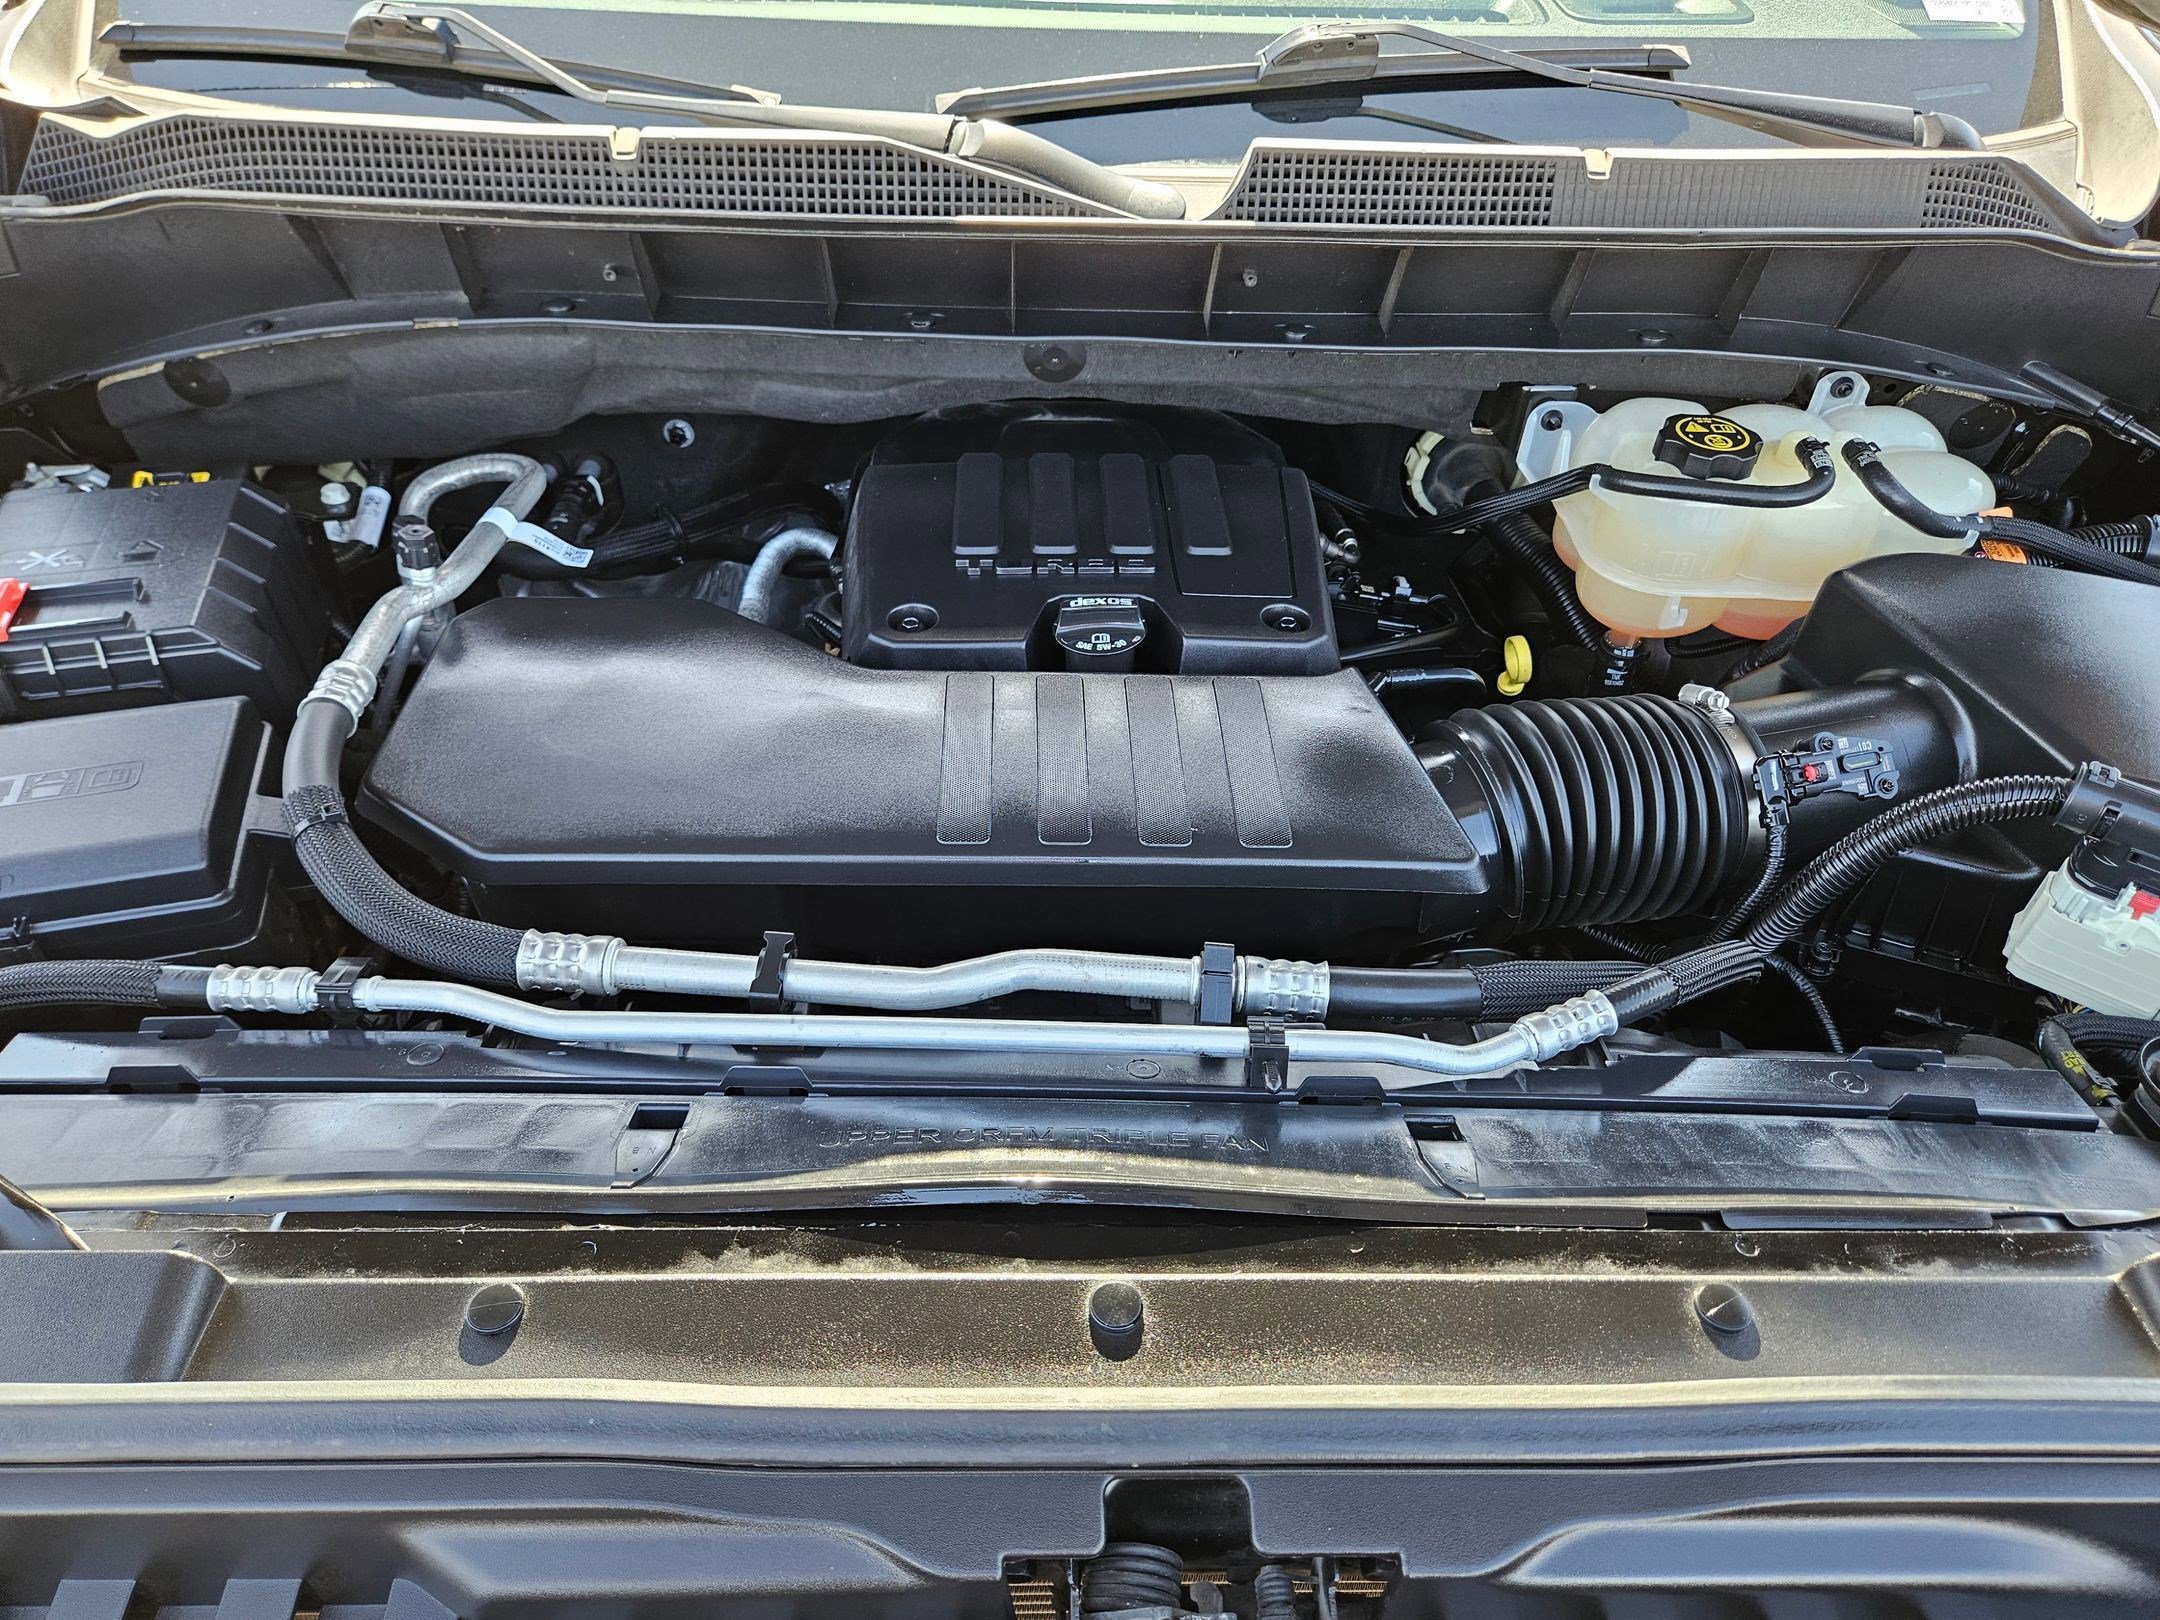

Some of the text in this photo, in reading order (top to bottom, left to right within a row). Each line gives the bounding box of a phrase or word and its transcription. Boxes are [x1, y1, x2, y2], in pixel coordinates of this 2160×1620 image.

[1069, 597, 1133, 608] dexos
[1075, 638, 1127, 651] SAE 5W-30
[818, 1126, 1271, 1152] UPPER CRFM TRIPLE FAN
